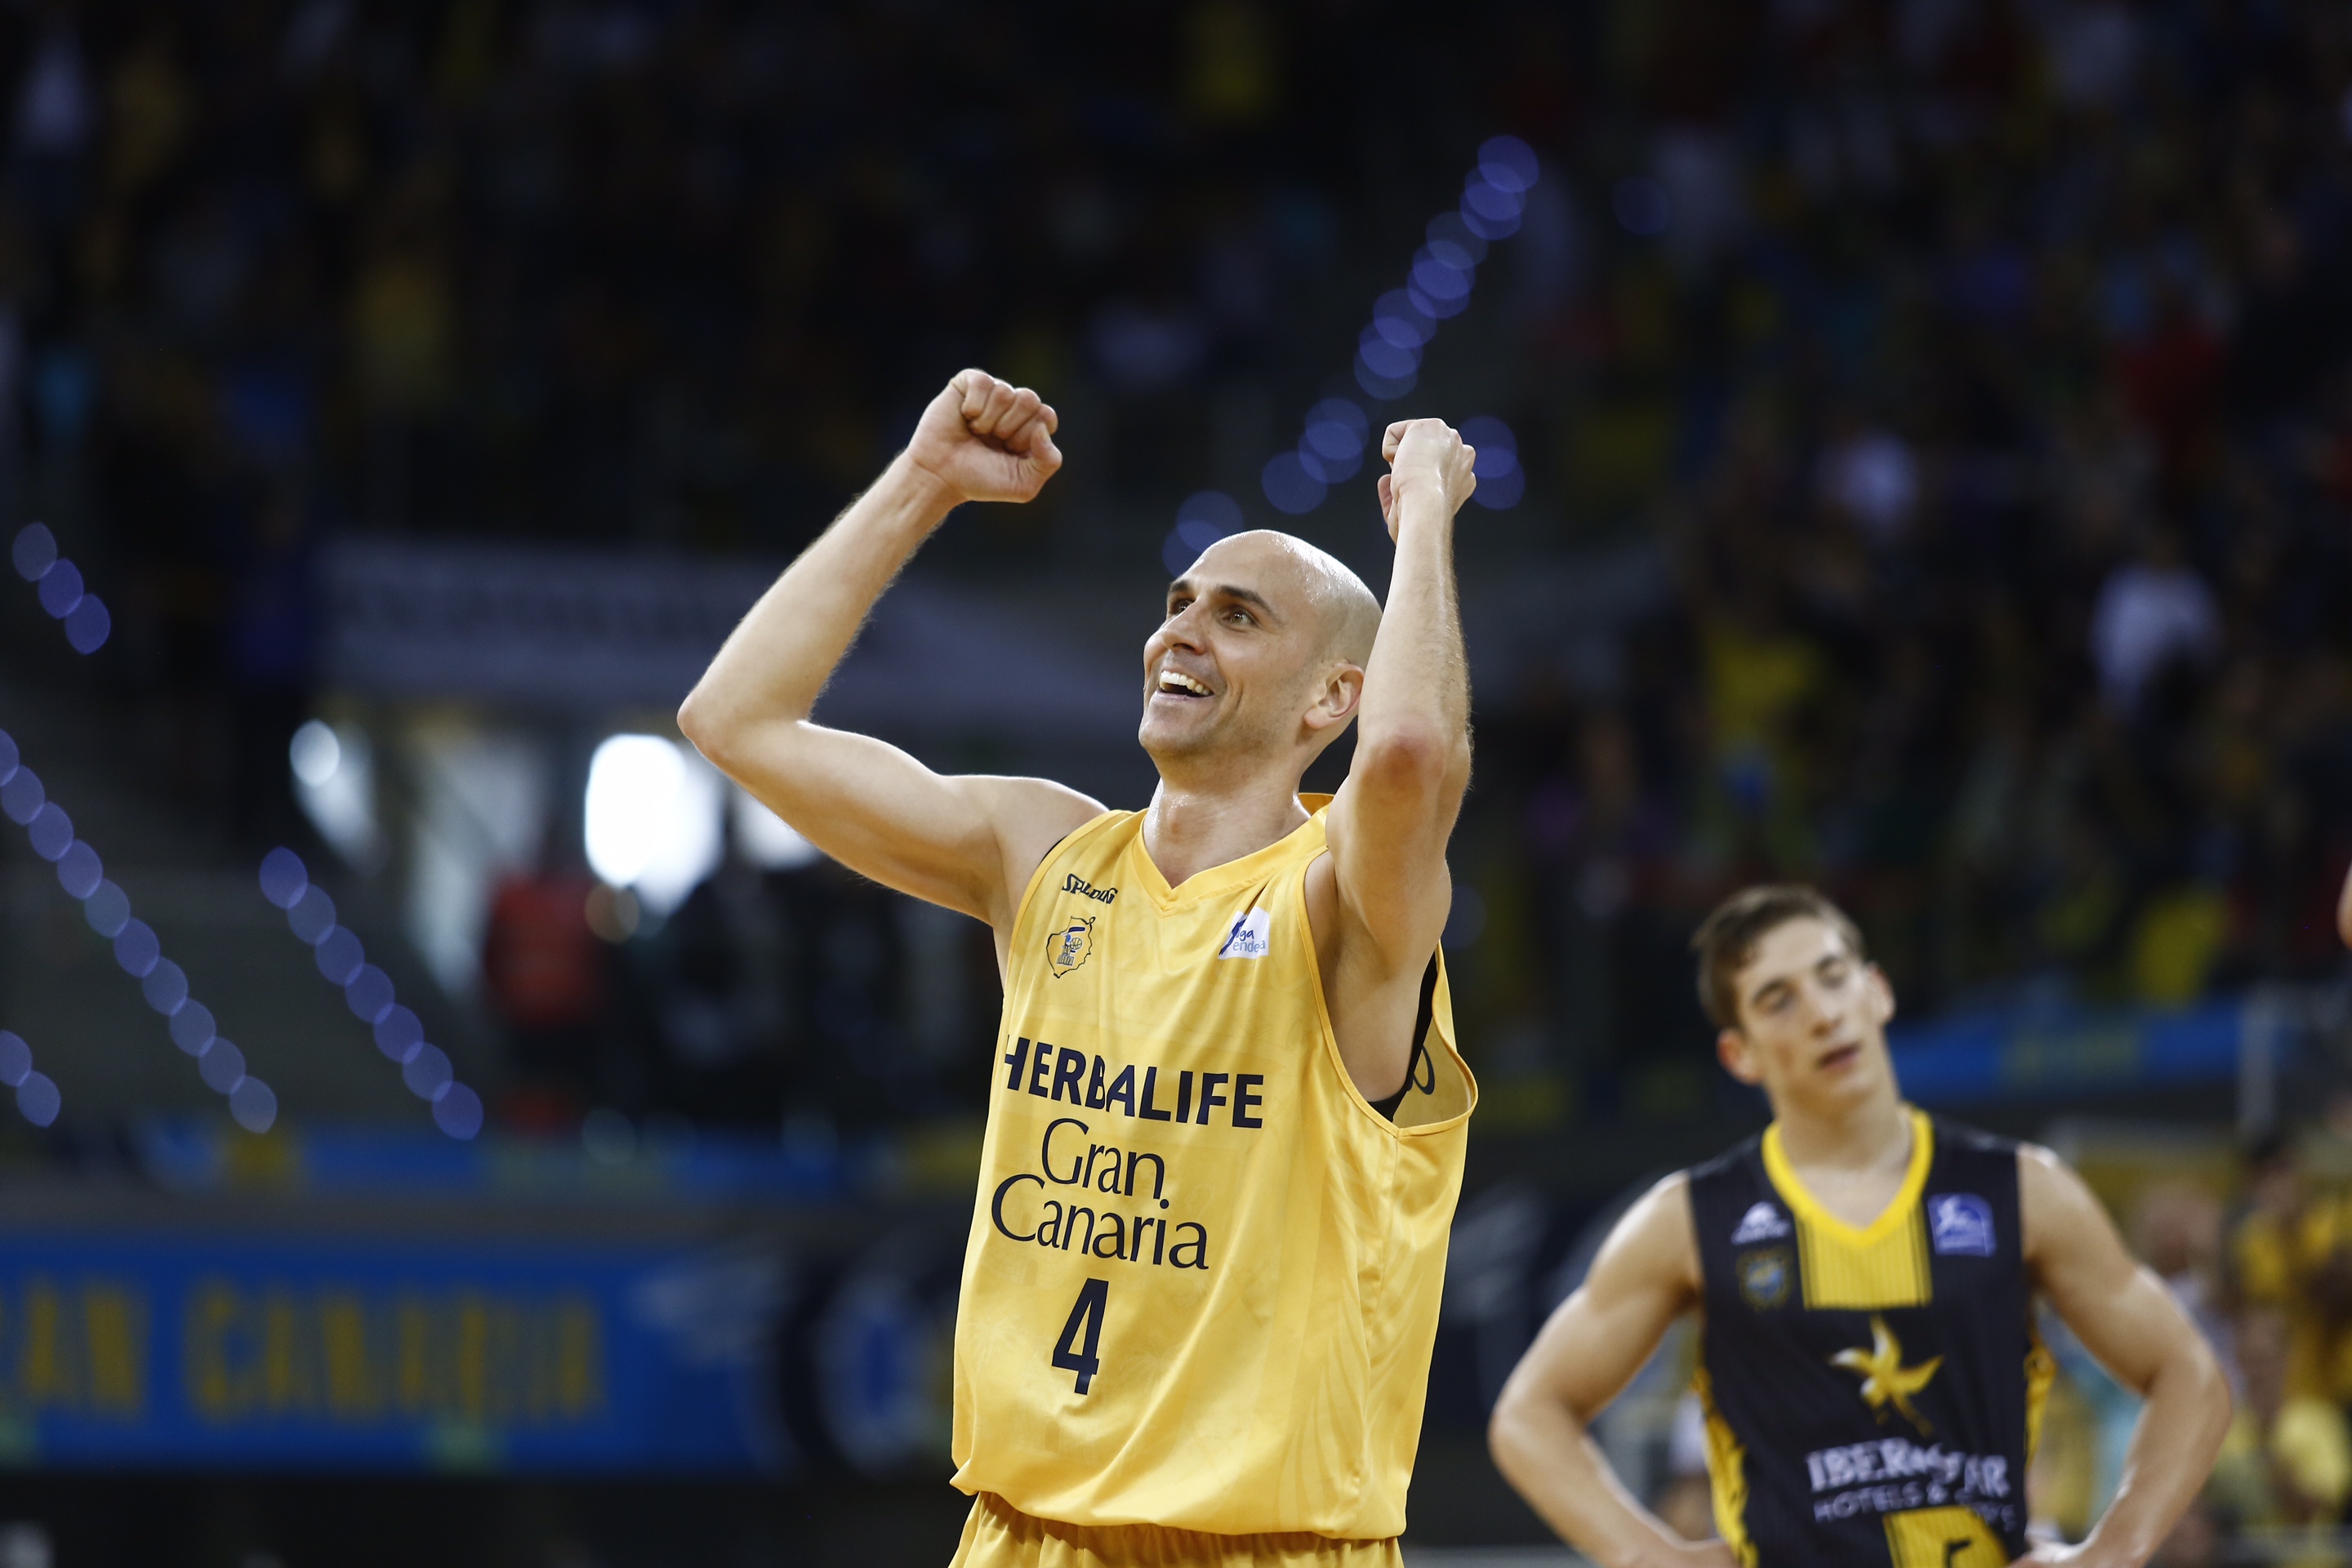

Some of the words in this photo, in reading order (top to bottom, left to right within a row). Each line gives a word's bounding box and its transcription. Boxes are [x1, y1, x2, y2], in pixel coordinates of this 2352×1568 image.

[1062, 873, 1118, 904] SPLDING
[1232, 939, 1265, 953] endea
[1004, 1034, 1263, 1129] HERBALIFE
[1041, 1118, 1165, 1200] Gran
[991, 1174, 1209, 1270] Canaria
[1052, 1277, 1109, 1395] 4
